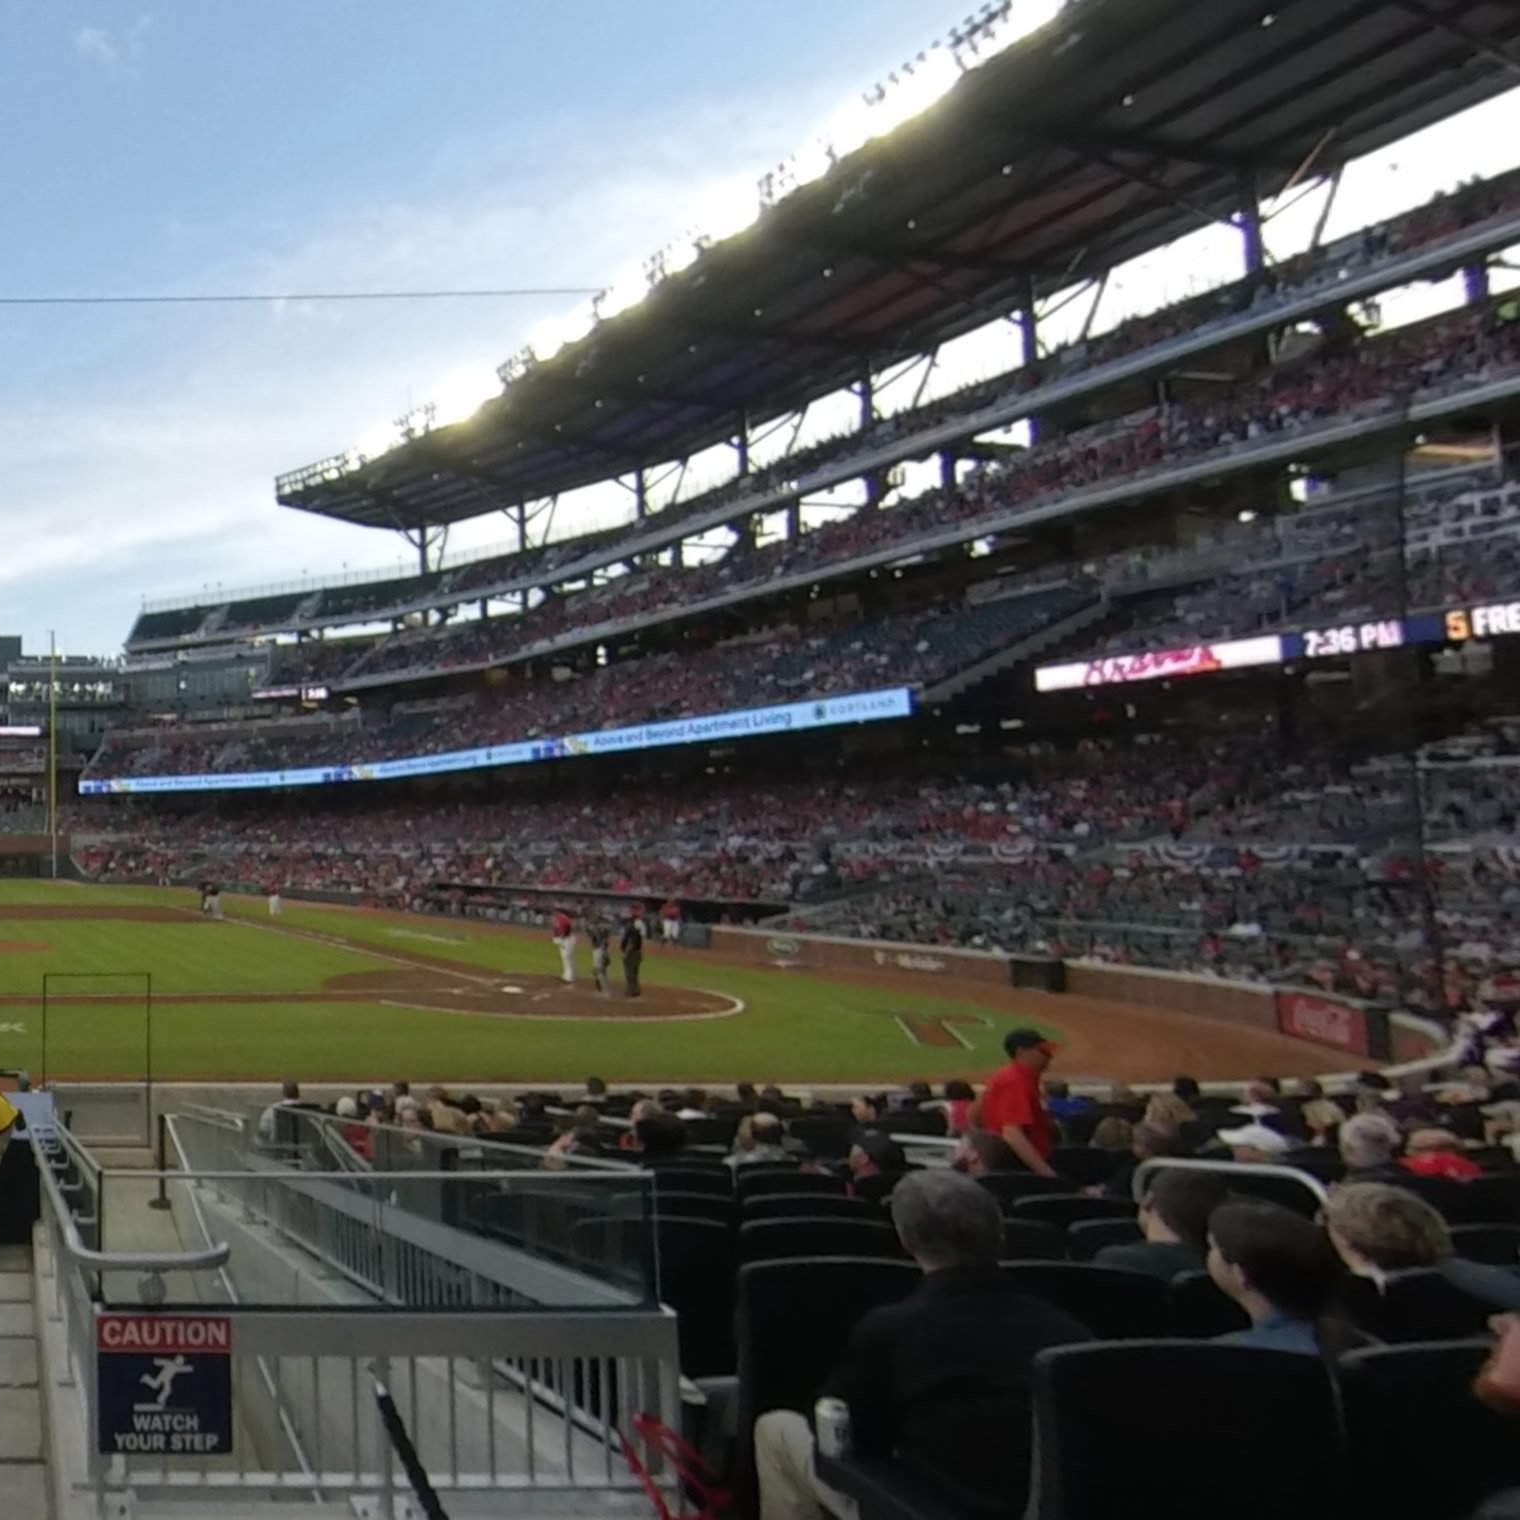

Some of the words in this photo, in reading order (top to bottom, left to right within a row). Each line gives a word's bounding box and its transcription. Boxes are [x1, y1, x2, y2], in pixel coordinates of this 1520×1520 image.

[1362, 620, 1402, 648] PM
[594, 734, 623, 746] Above
[645, 727, 685, 742] Beyond
[688, 717, 750, 737] Apartment
[753, 710, 793, 729] Living
[102, 1320, 228, 1346] CAUTION
[132, 1414, 199, 1432] WATCH
[113, 1433, 165, 1451] YOUR
[170, 1433, 218, 1450] STEP
